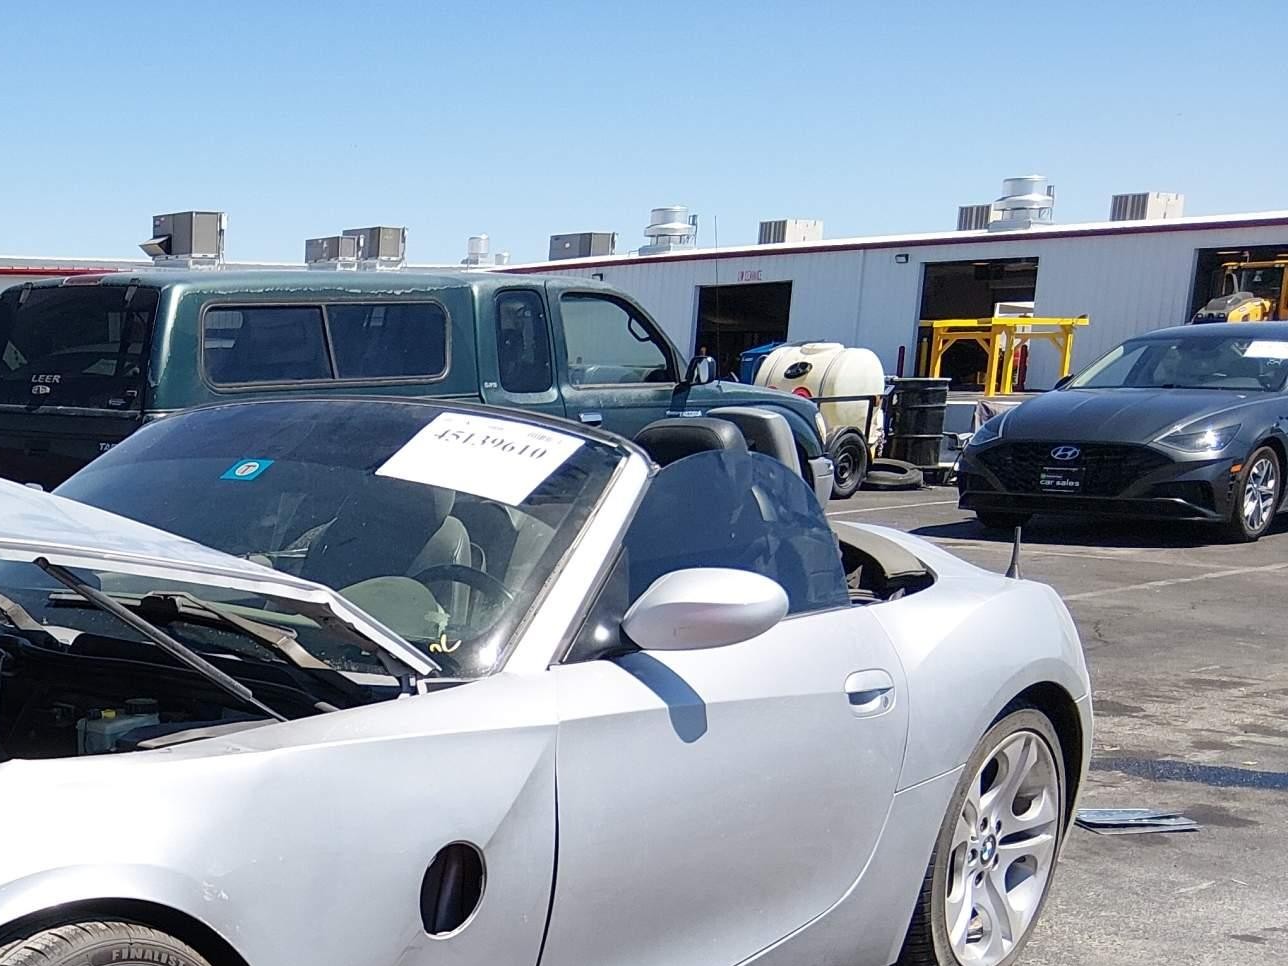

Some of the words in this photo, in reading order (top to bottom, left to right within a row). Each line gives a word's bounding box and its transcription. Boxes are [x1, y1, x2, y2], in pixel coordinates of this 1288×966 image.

[32, 374, 61, 383] LEER
[434, 429, 547, 459] 45139610
[1056, 479, 1080, 487] sales
